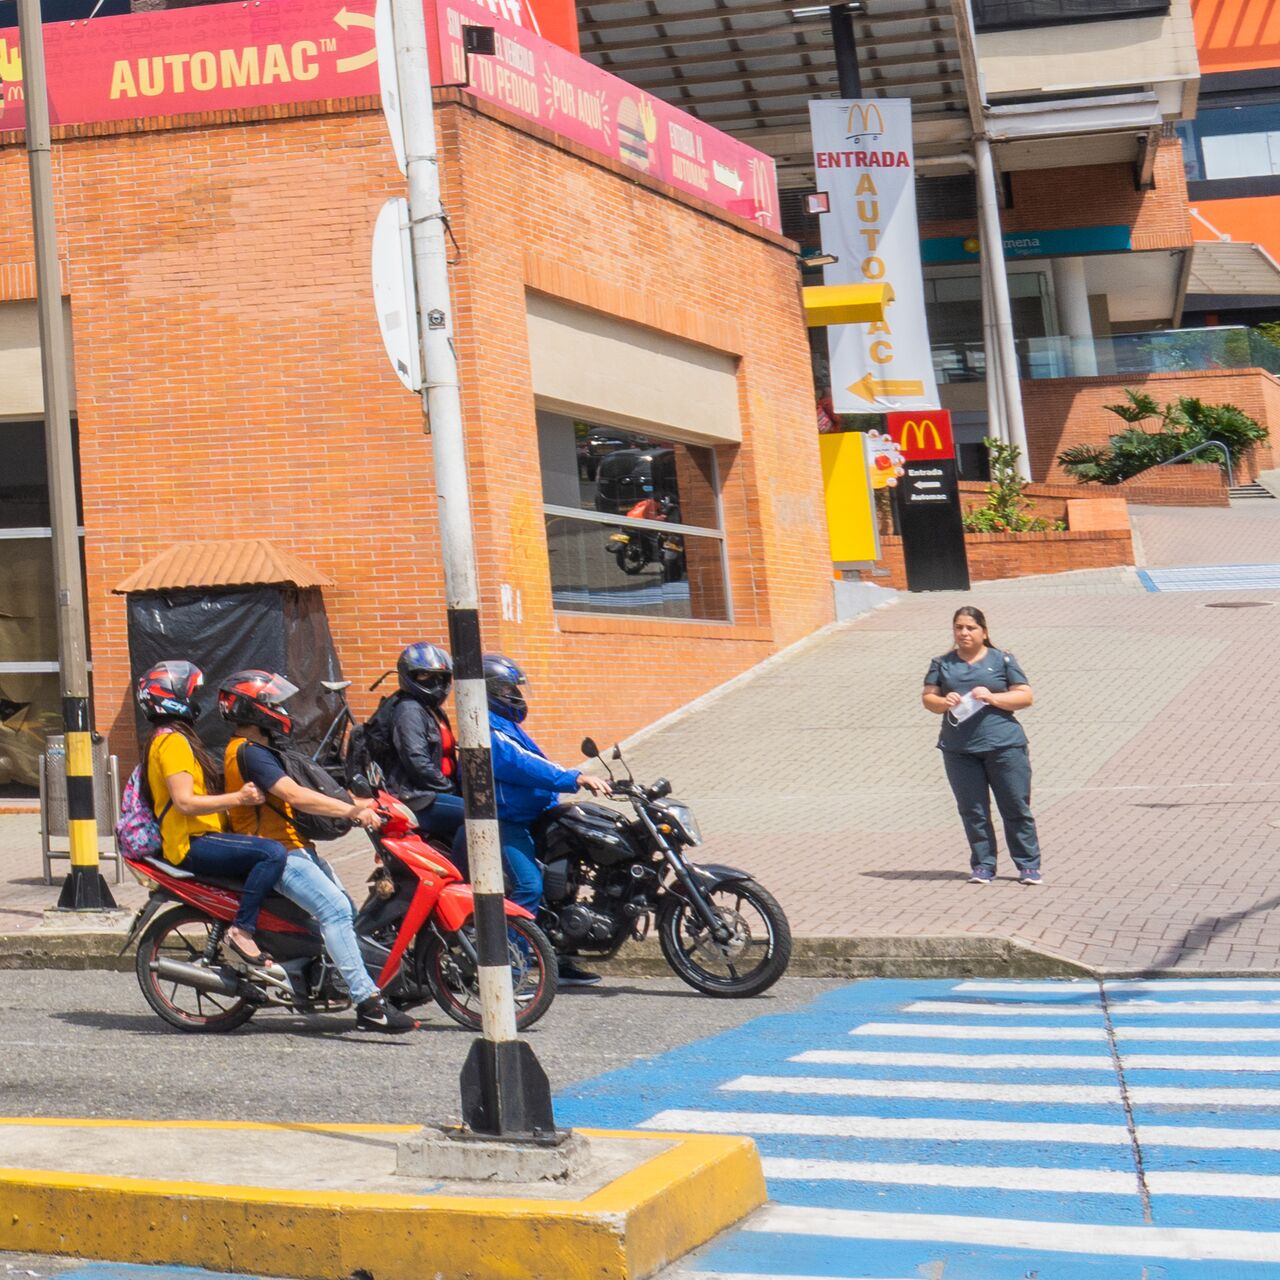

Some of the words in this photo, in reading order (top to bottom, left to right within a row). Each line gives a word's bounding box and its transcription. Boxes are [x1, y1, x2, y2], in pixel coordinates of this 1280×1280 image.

[478, 55, 495, 97] TU
[496, 64, 540, 118] PEDIDO
[552, 75, 577, 118] POR
[816, 151, 910, 169] ENTRADA
[854, 173, 894, 364] AUTOAC
